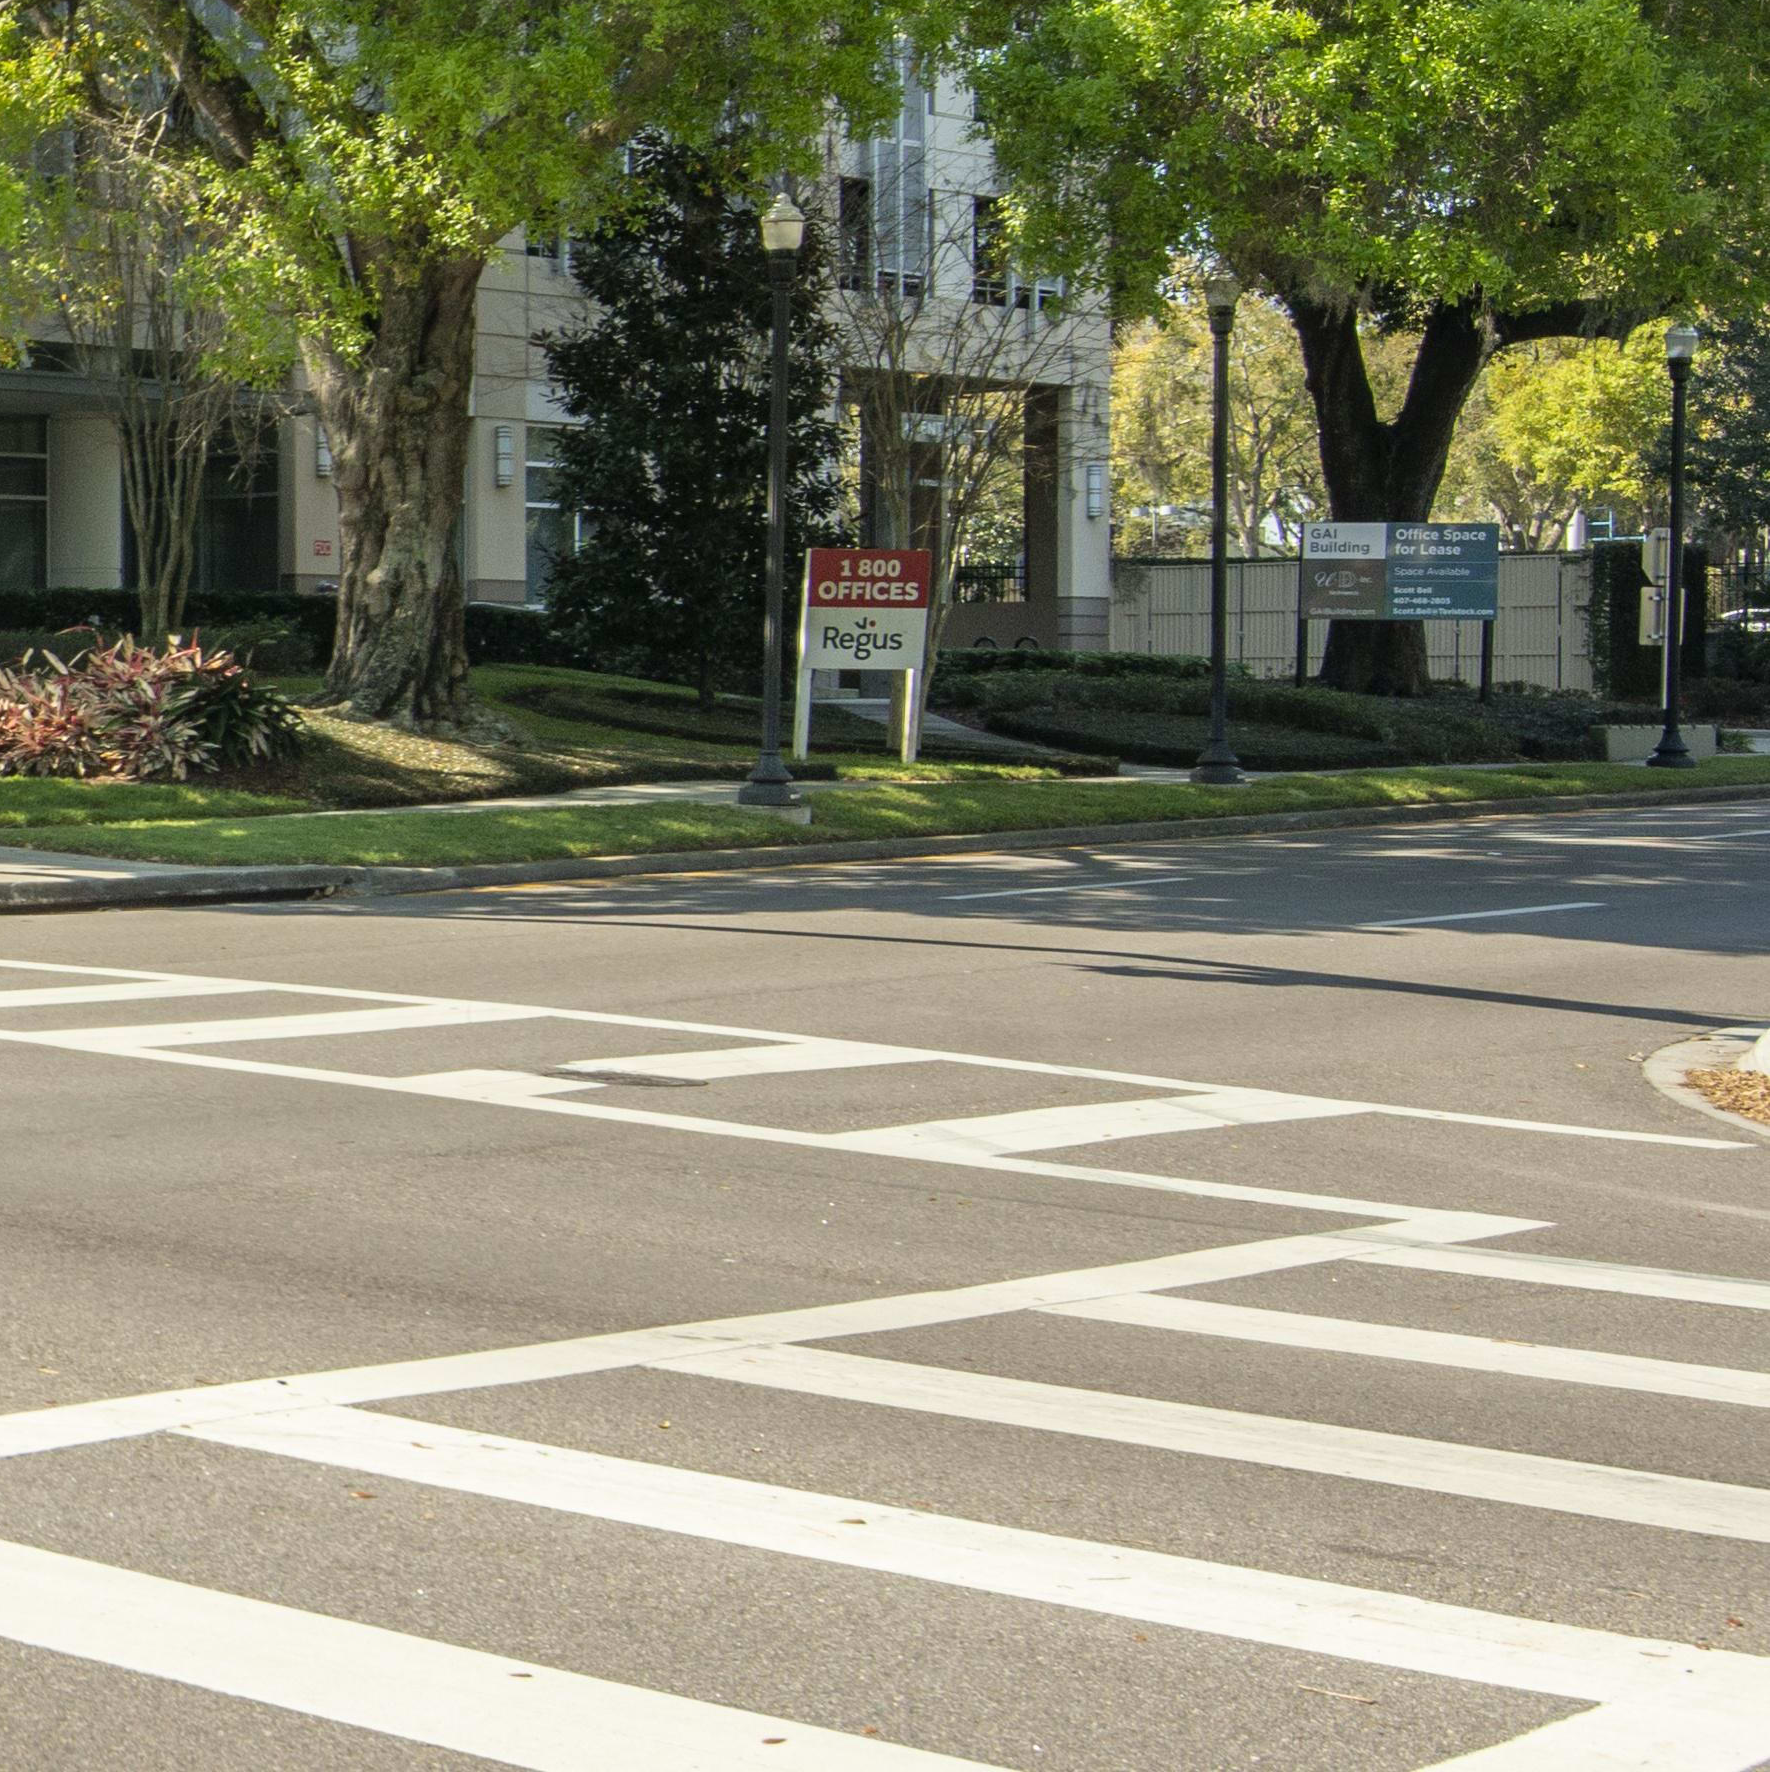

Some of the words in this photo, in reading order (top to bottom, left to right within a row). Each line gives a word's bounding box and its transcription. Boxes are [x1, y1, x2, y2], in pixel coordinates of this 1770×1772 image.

[1310, 528, 1338, 540] GAI
[1395, 528, 1439, 540] Office
[1443, 529, 1487, 543] Space
[1310, 541, 1371, 555] Building
[1394, 543, 1416, 555] for
[1420, 543, 1461, 555] Lease
[841, 559, 852, 577] 1
[857, 559, 902, 577] 800
[1394, 567, 1424, 577] Space
[1426, 567, 1470, 576] Available
[818, 580, 919, 601] OFFICES
[822, 625, 903, 660] Regus
